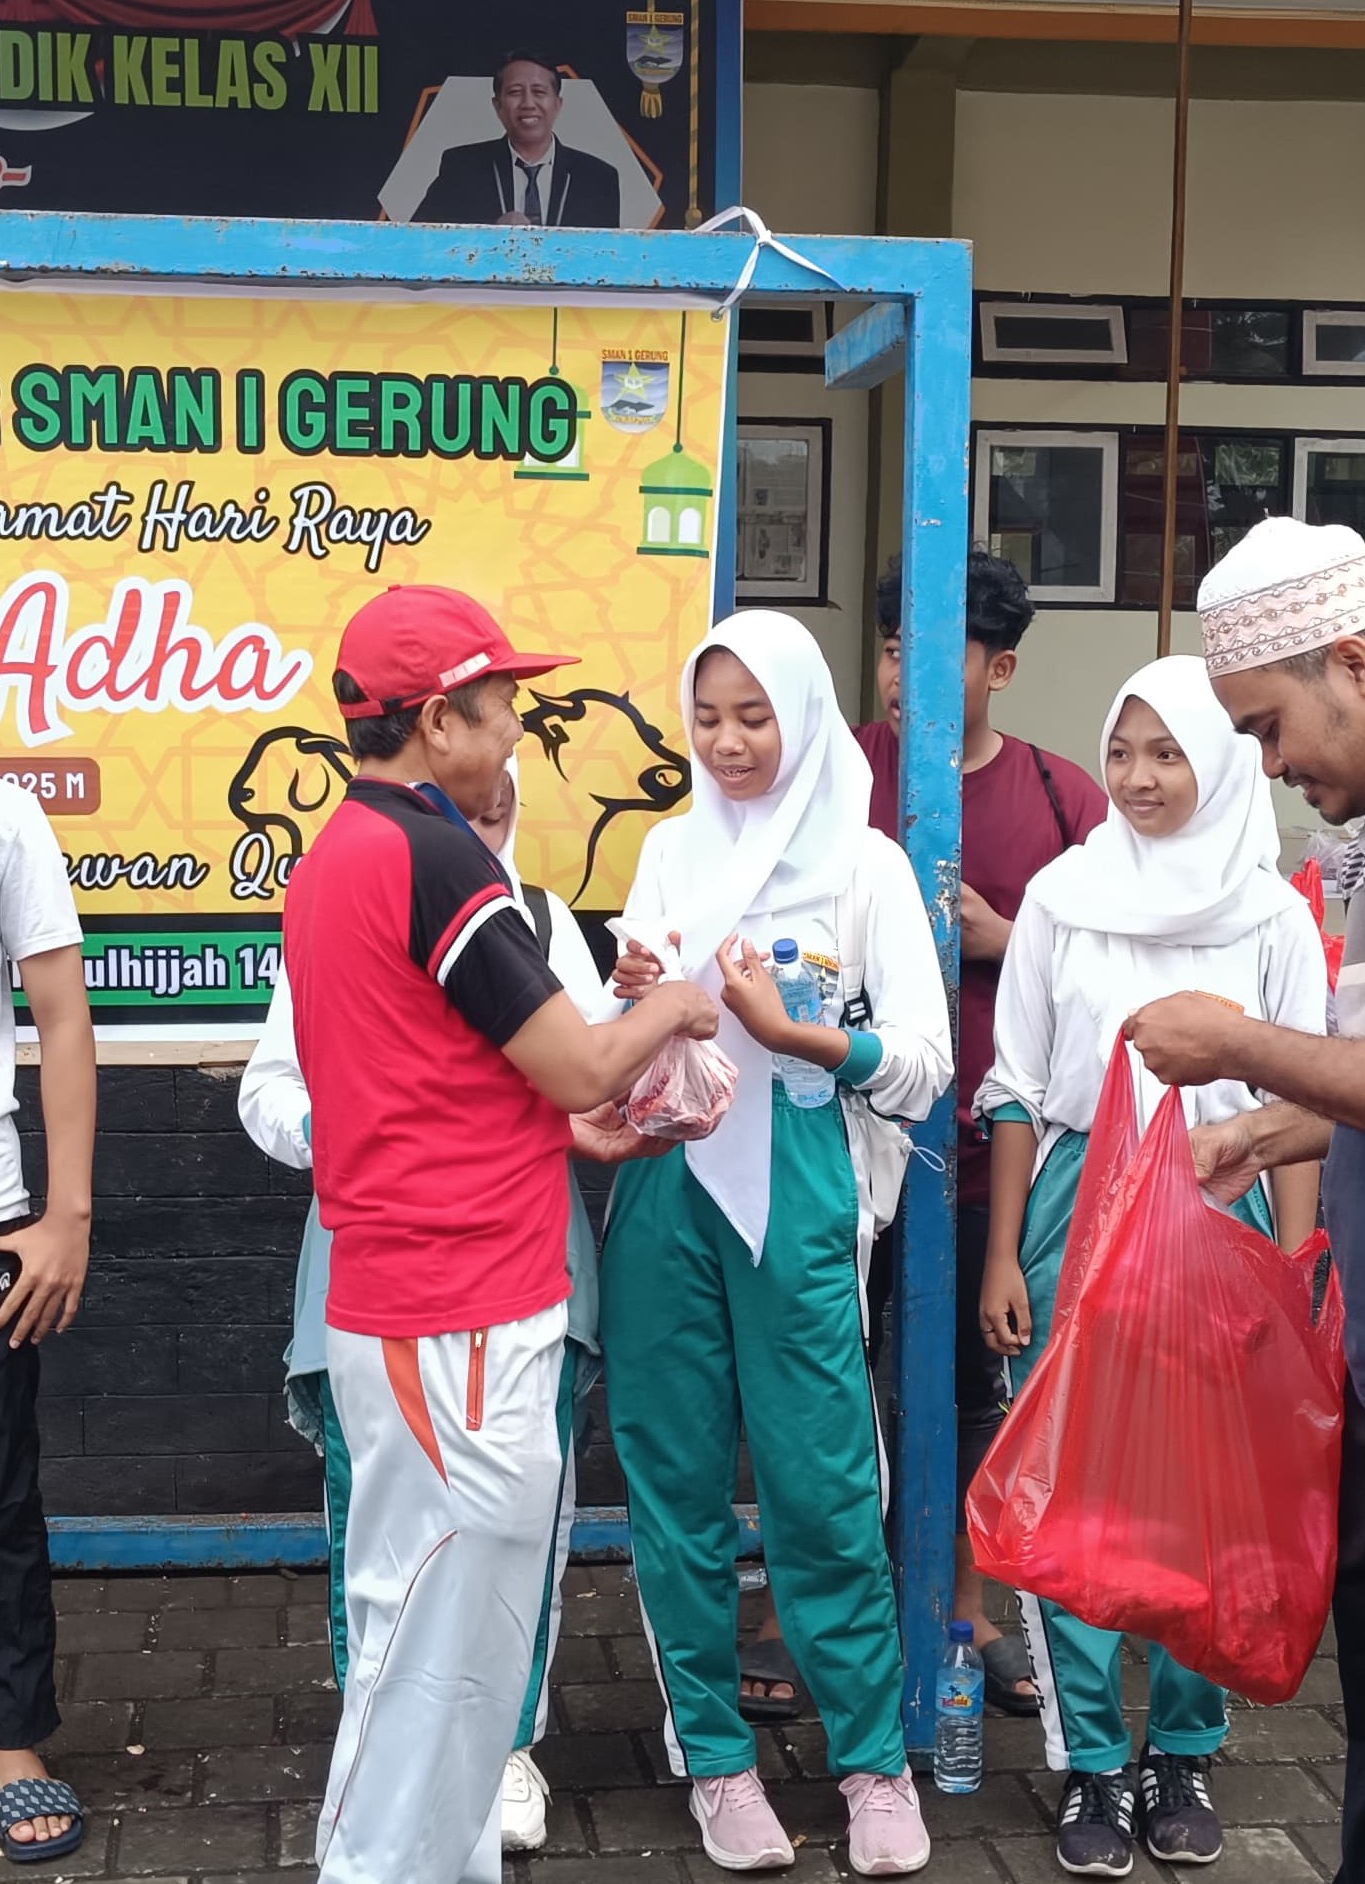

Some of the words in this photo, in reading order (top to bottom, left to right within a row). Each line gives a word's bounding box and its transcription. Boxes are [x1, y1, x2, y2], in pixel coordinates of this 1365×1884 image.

[113, 34, 288, 112] KELAS
[309, 43, 379, 115] XII
[602, 349, 626, 360] SMAN
[635, 350, 669, 361] GERUNG
[15, 365, 226, 454] SMAN
[279, 371, 575, 460] GERUNG
[141, 482, 276, 553] Hari
[285, 486, 427, 572] Raya
[65, 771, 85, 799] M
[84, 946, 227, 994] ulhijjah
[238, 945, 279, 986] 14
